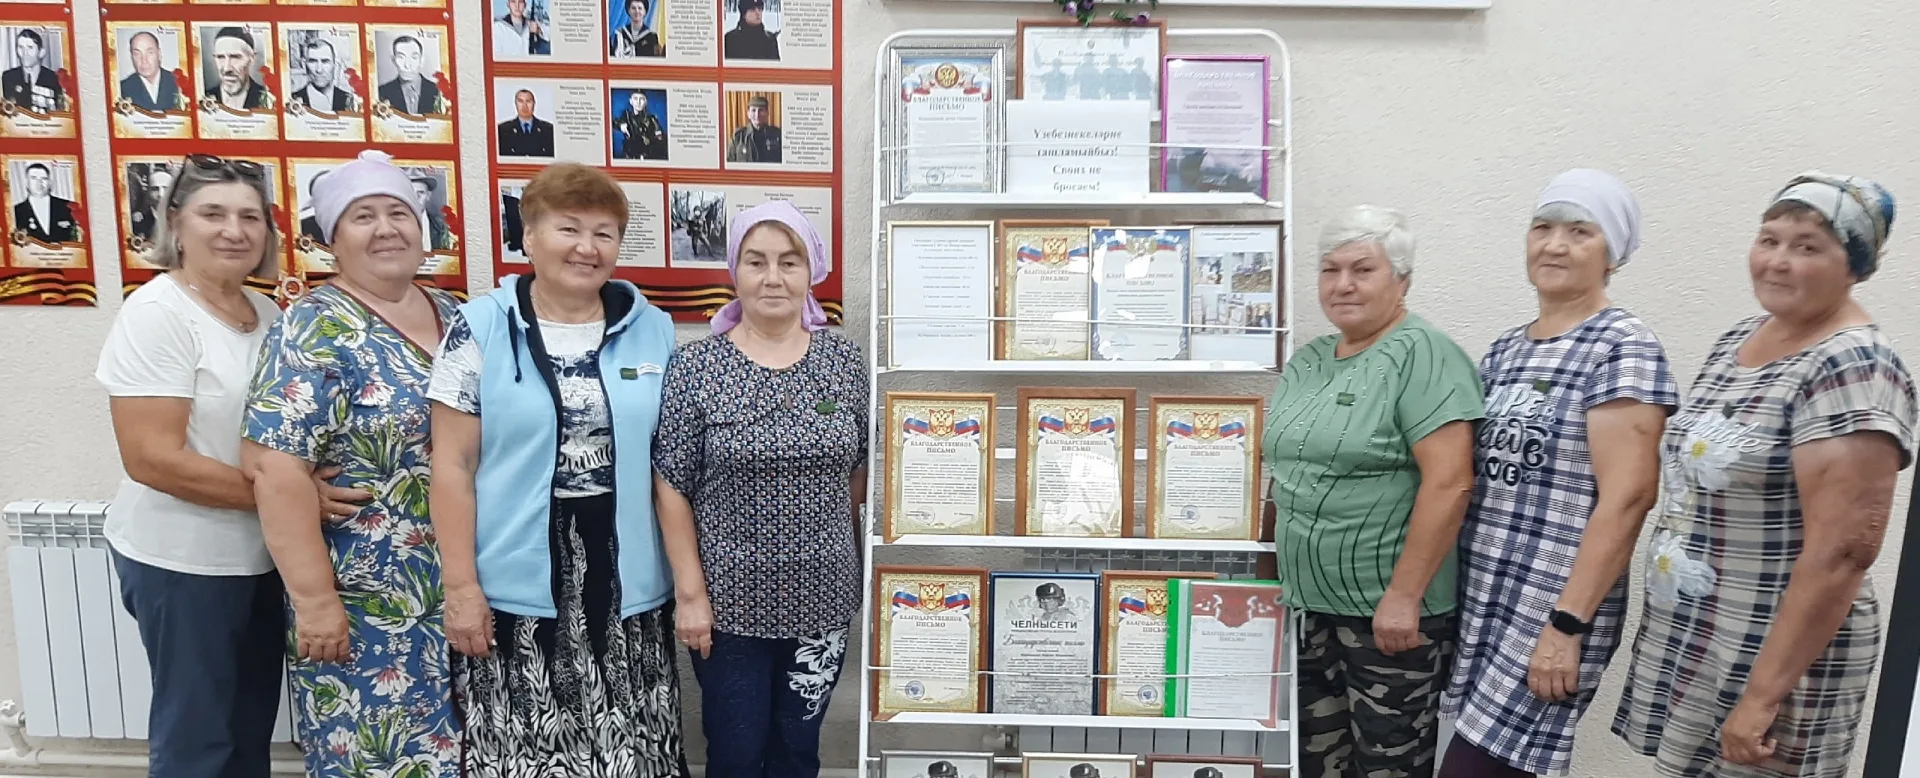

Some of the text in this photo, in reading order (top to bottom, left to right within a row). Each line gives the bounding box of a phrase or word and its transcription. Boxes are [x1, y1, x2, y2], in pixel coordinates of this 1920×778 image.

[1052, 164, 1101, 175] Своих не
[1011, 619, 1078, 629] ЧЕЛНЫСЕТИ
